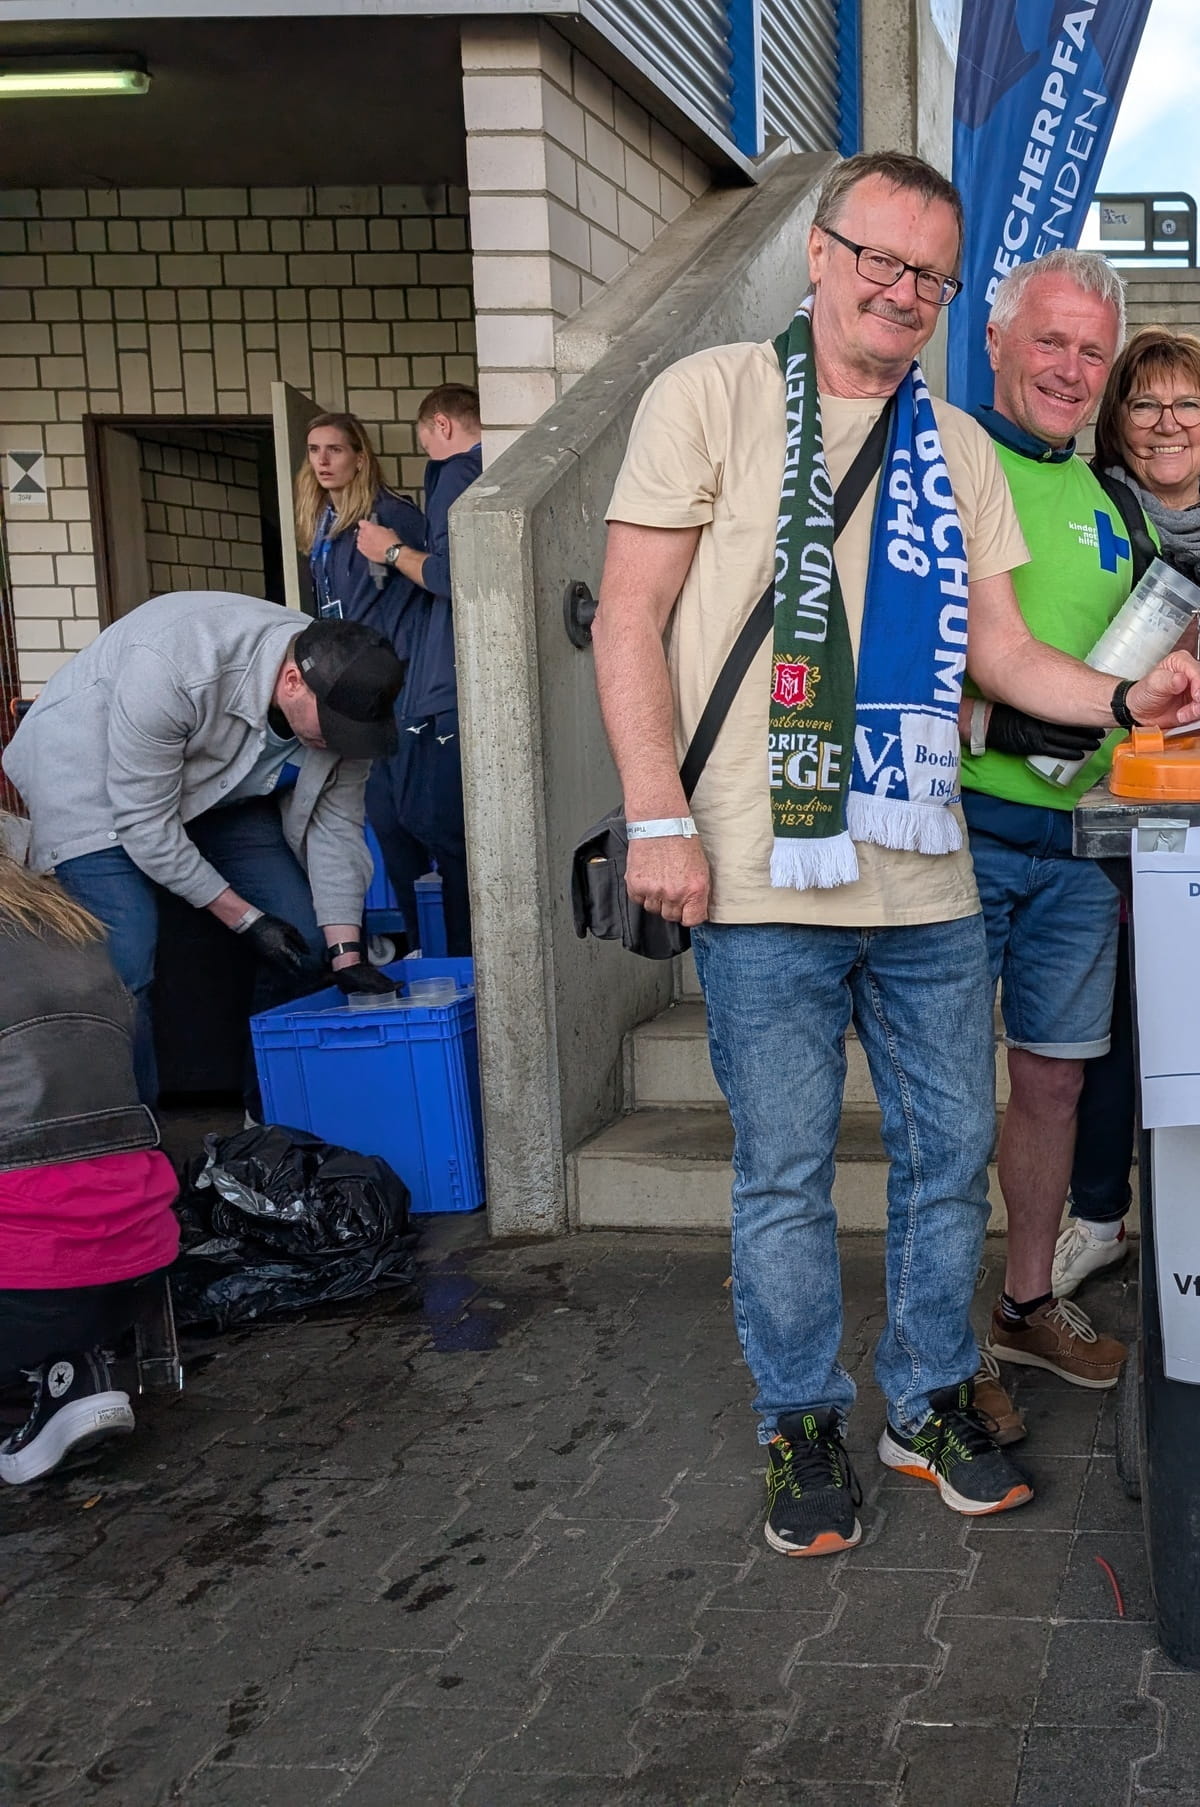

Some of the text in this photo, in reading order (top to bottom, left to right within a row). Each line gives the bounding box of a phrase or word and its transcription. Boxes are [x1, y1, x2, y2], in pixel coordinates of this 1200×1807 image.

[985, 0, 1099, 306] ECHERPFA
[1068, 522, 1097, 533] kinder
[1083, 531, 1098, 540] not
[1078, 536, 1099, 547] hilfe
[915, 430, 968, 704] BOCHUM
[794, 542, 833, 643] UND
[929, 778, 955, 797] 184
